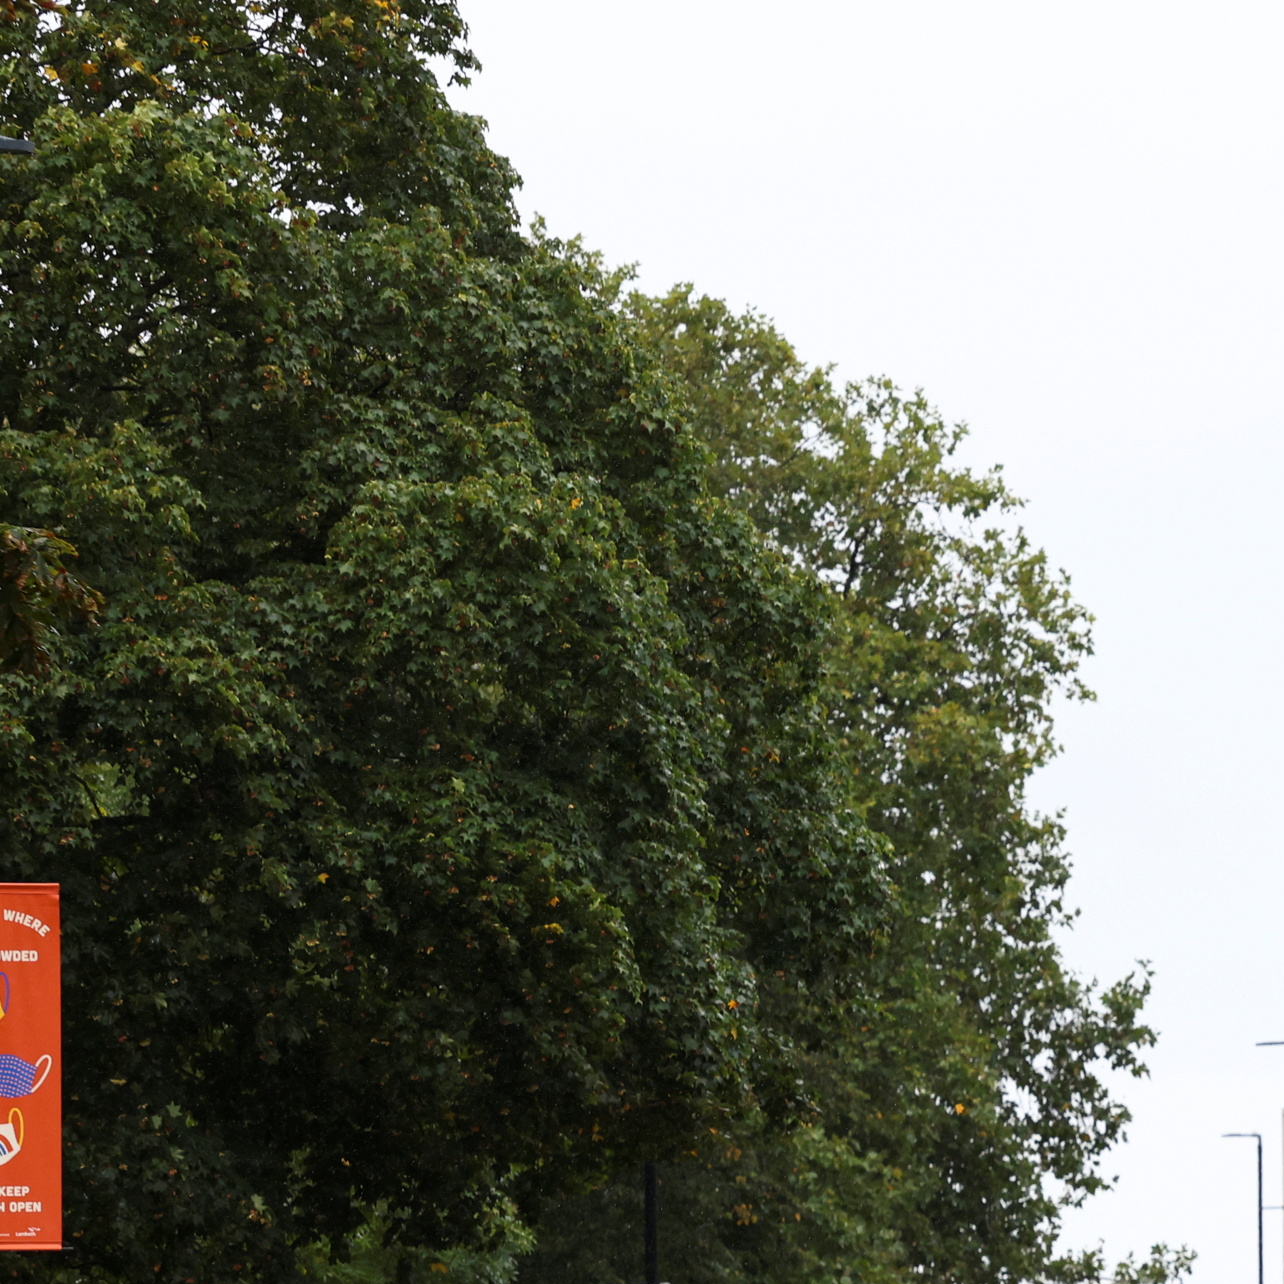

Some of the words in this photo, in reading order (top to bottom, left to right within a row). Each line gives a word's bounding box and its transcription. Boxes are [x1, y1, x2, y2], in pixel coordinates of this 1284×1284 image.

[3, 908, 51, 937] WHERE
[0, 1186, 30, 1197] KEEP
[9, 1201, 42, 1213] OPEN
